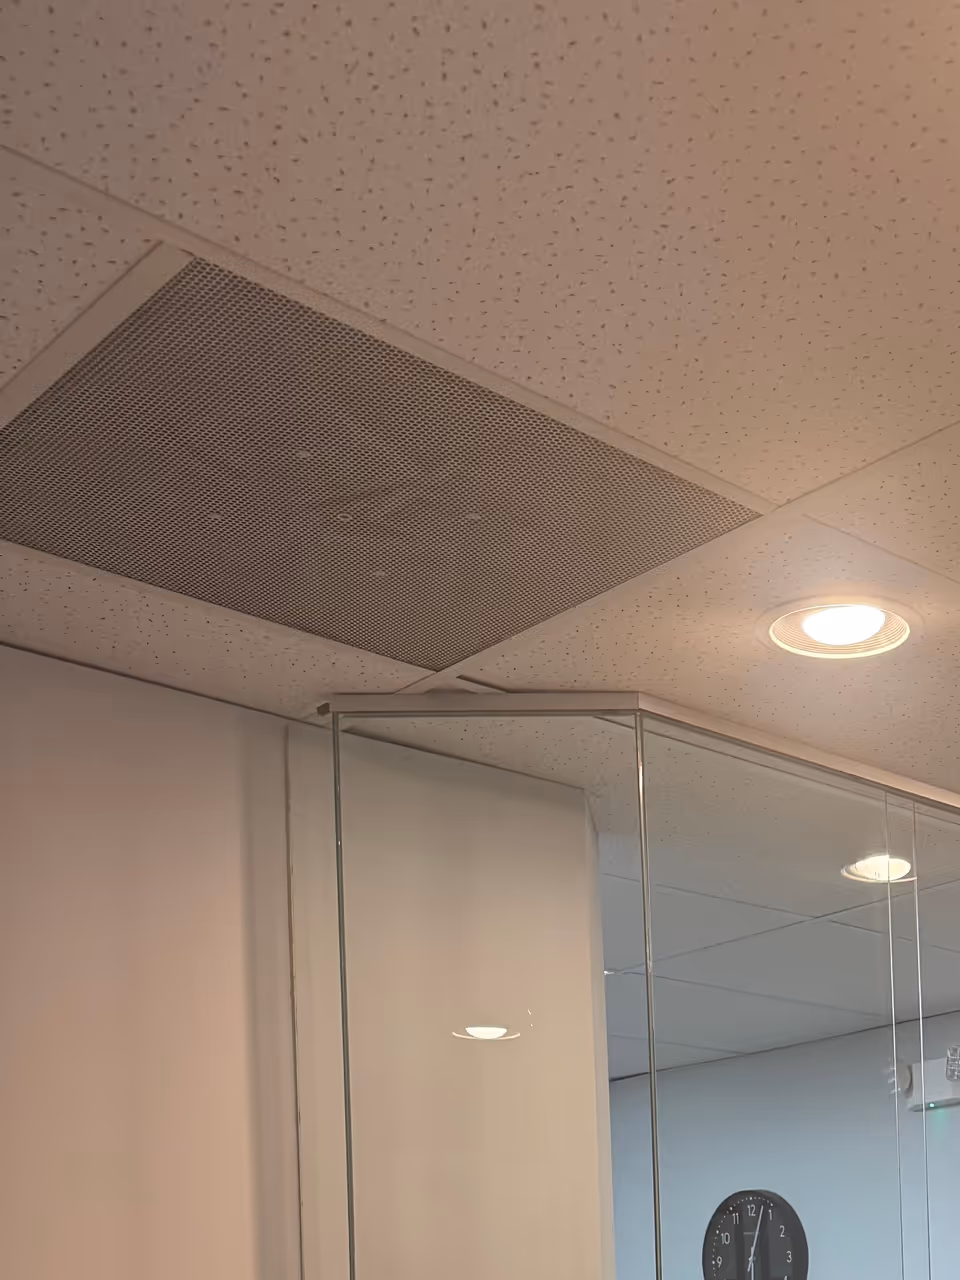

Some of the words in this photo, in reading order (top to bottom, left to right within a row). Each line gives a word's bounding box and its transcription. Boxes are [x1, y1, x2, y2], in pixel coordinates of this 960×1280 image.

[747, 1204, 756, 1216] 12
[768, 1209, 772, 1220] 1
[732, 1212, 739, 1224] 11
[780, 1225, 785, 1238] 2
[721, 1232, 730, 1244] 10
[717, 1256, 722, 1268] 9
[786, 1250, 792, 1263] 3
